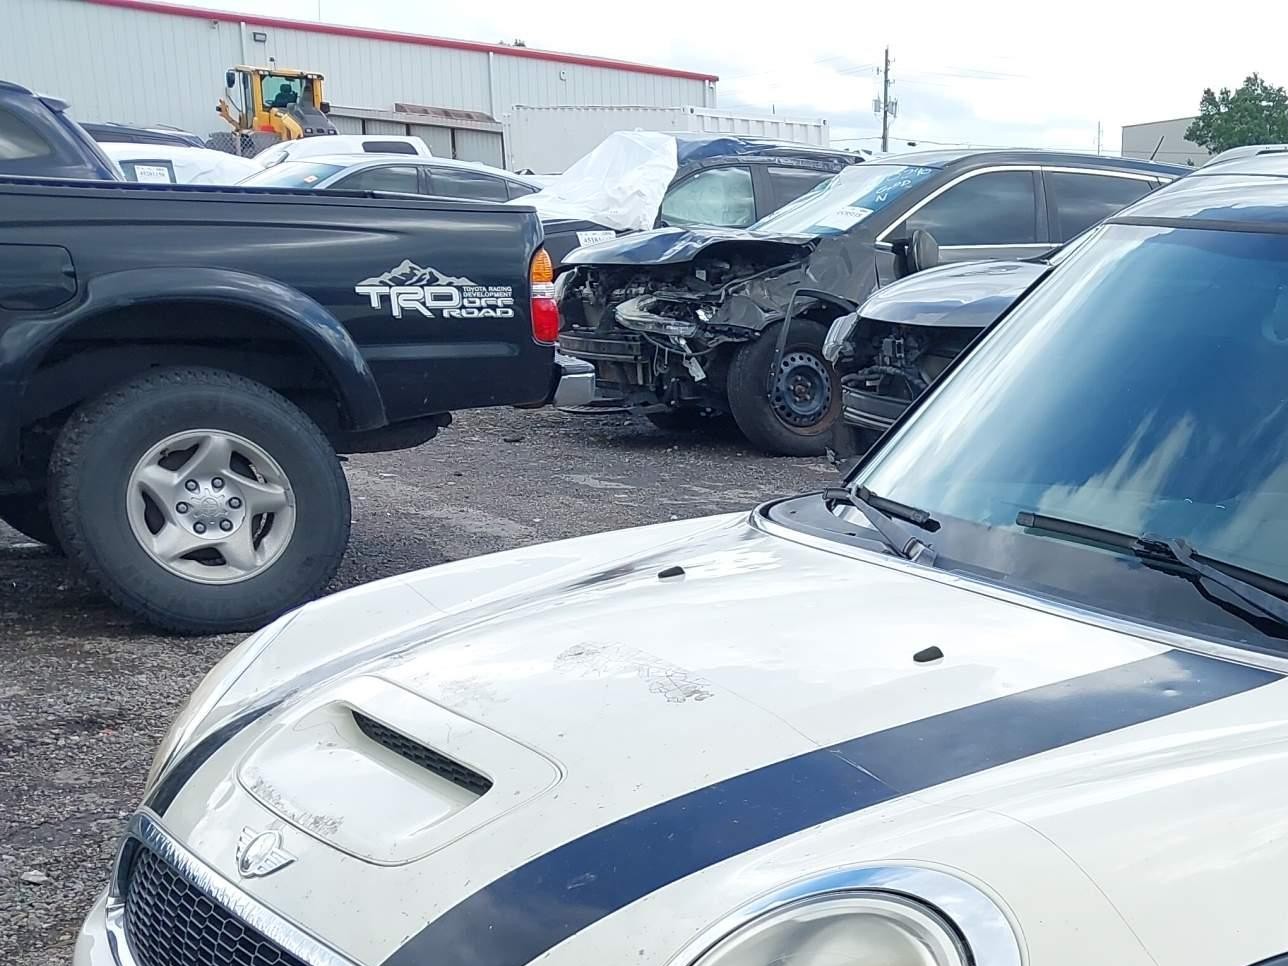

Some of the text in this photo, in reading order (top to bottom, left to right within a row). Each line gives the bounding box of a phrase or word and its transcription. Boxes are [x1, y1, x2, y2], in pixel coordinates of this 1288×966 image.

[355, 286, 462, 318] TRD
[463, 298, 514, 307] OFF
[443, 308, 514, 318] ROAD
